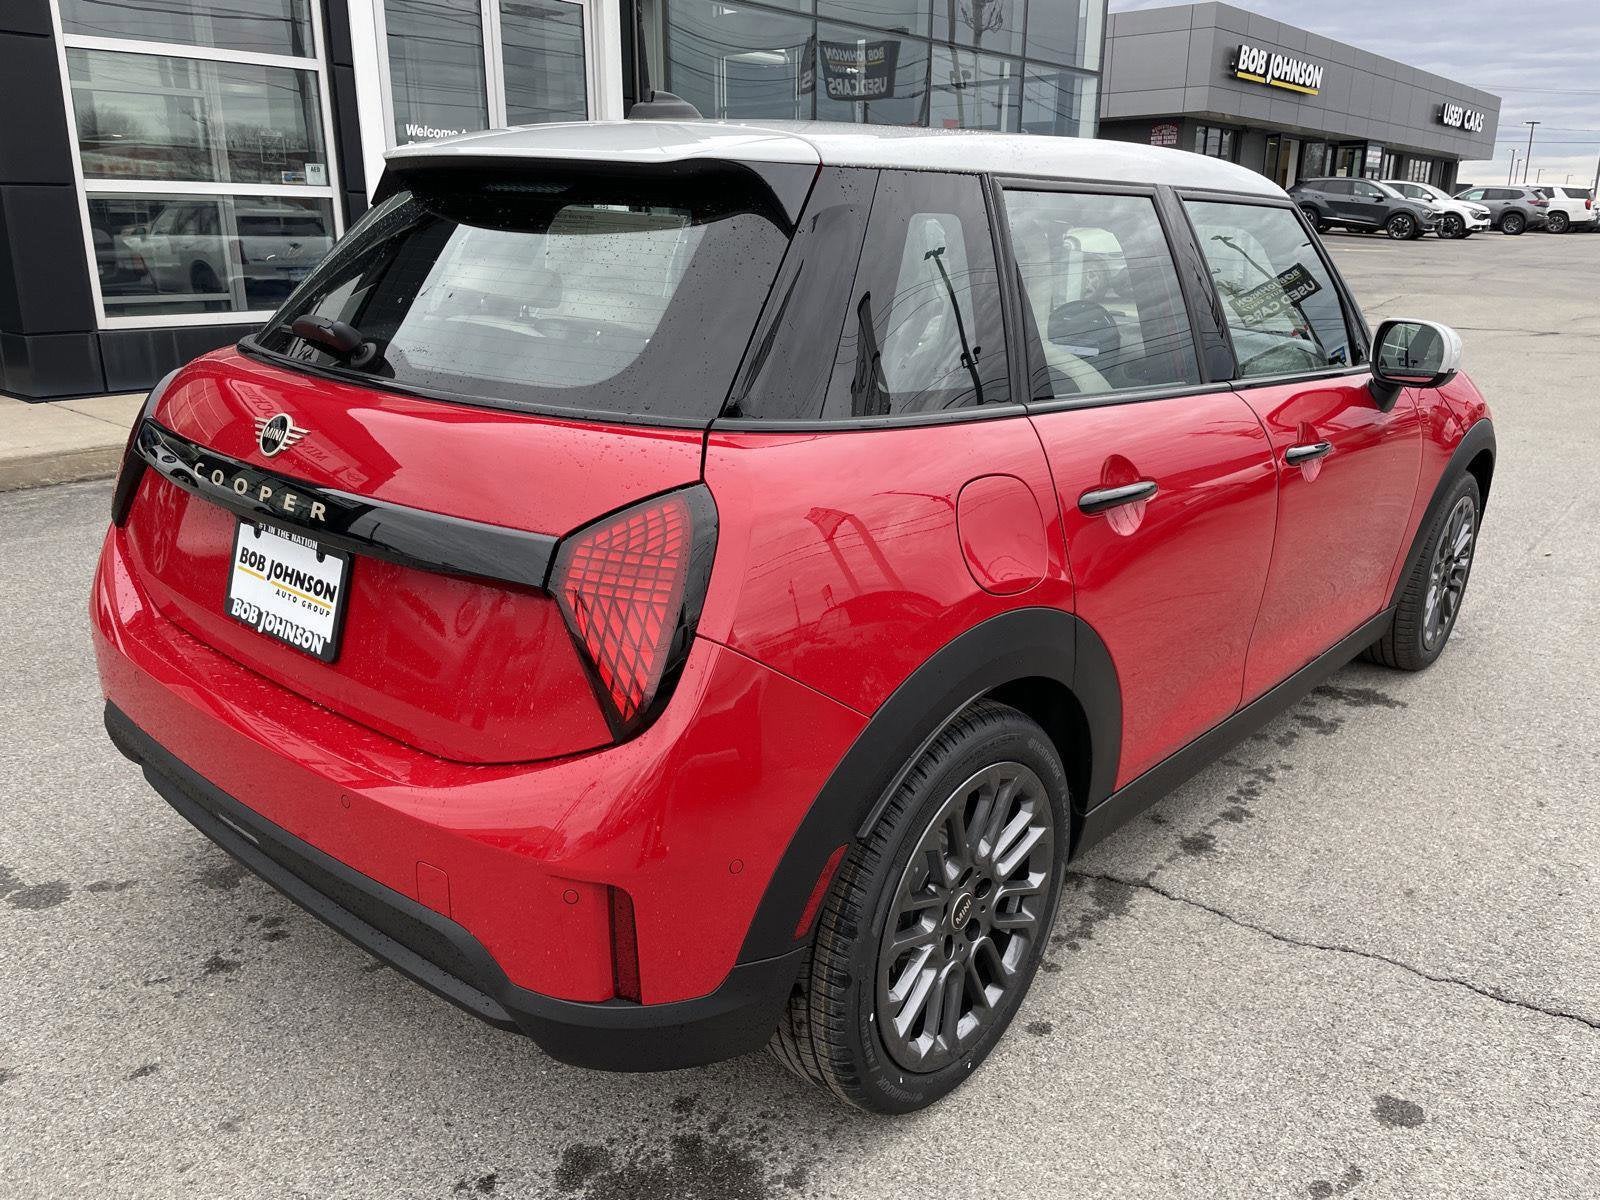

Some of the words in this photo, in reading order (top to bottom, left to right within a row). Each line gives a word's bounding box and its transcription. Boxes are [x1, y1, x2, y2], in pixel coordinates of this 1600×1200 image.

[1238, 44, 1267, 74] BOB
[1266, 53, 1323, 89] JOHNSON
[1443, 102, 1463, 127] USED
[1464, 109, 1485, 133] CARS
[263, 426, 285, 442] MINI
[193, 462, 326, 522] COOPER
[268, 525, 276, 535] IN
[277, 528, 290, 540] THE
[291, 533, 318, 550] NATION
[239, 546, 267, 572] BOB
[266, 559, 338, 603] JOHNSON
[275, 588, 298, 603] AUTO
[301, 600, 331, 618] GROUP
[231, 598, 260, 624] BOB
[257, 611, 326, 655] JOHNSON
[955, 899, 972, 924] MINI
